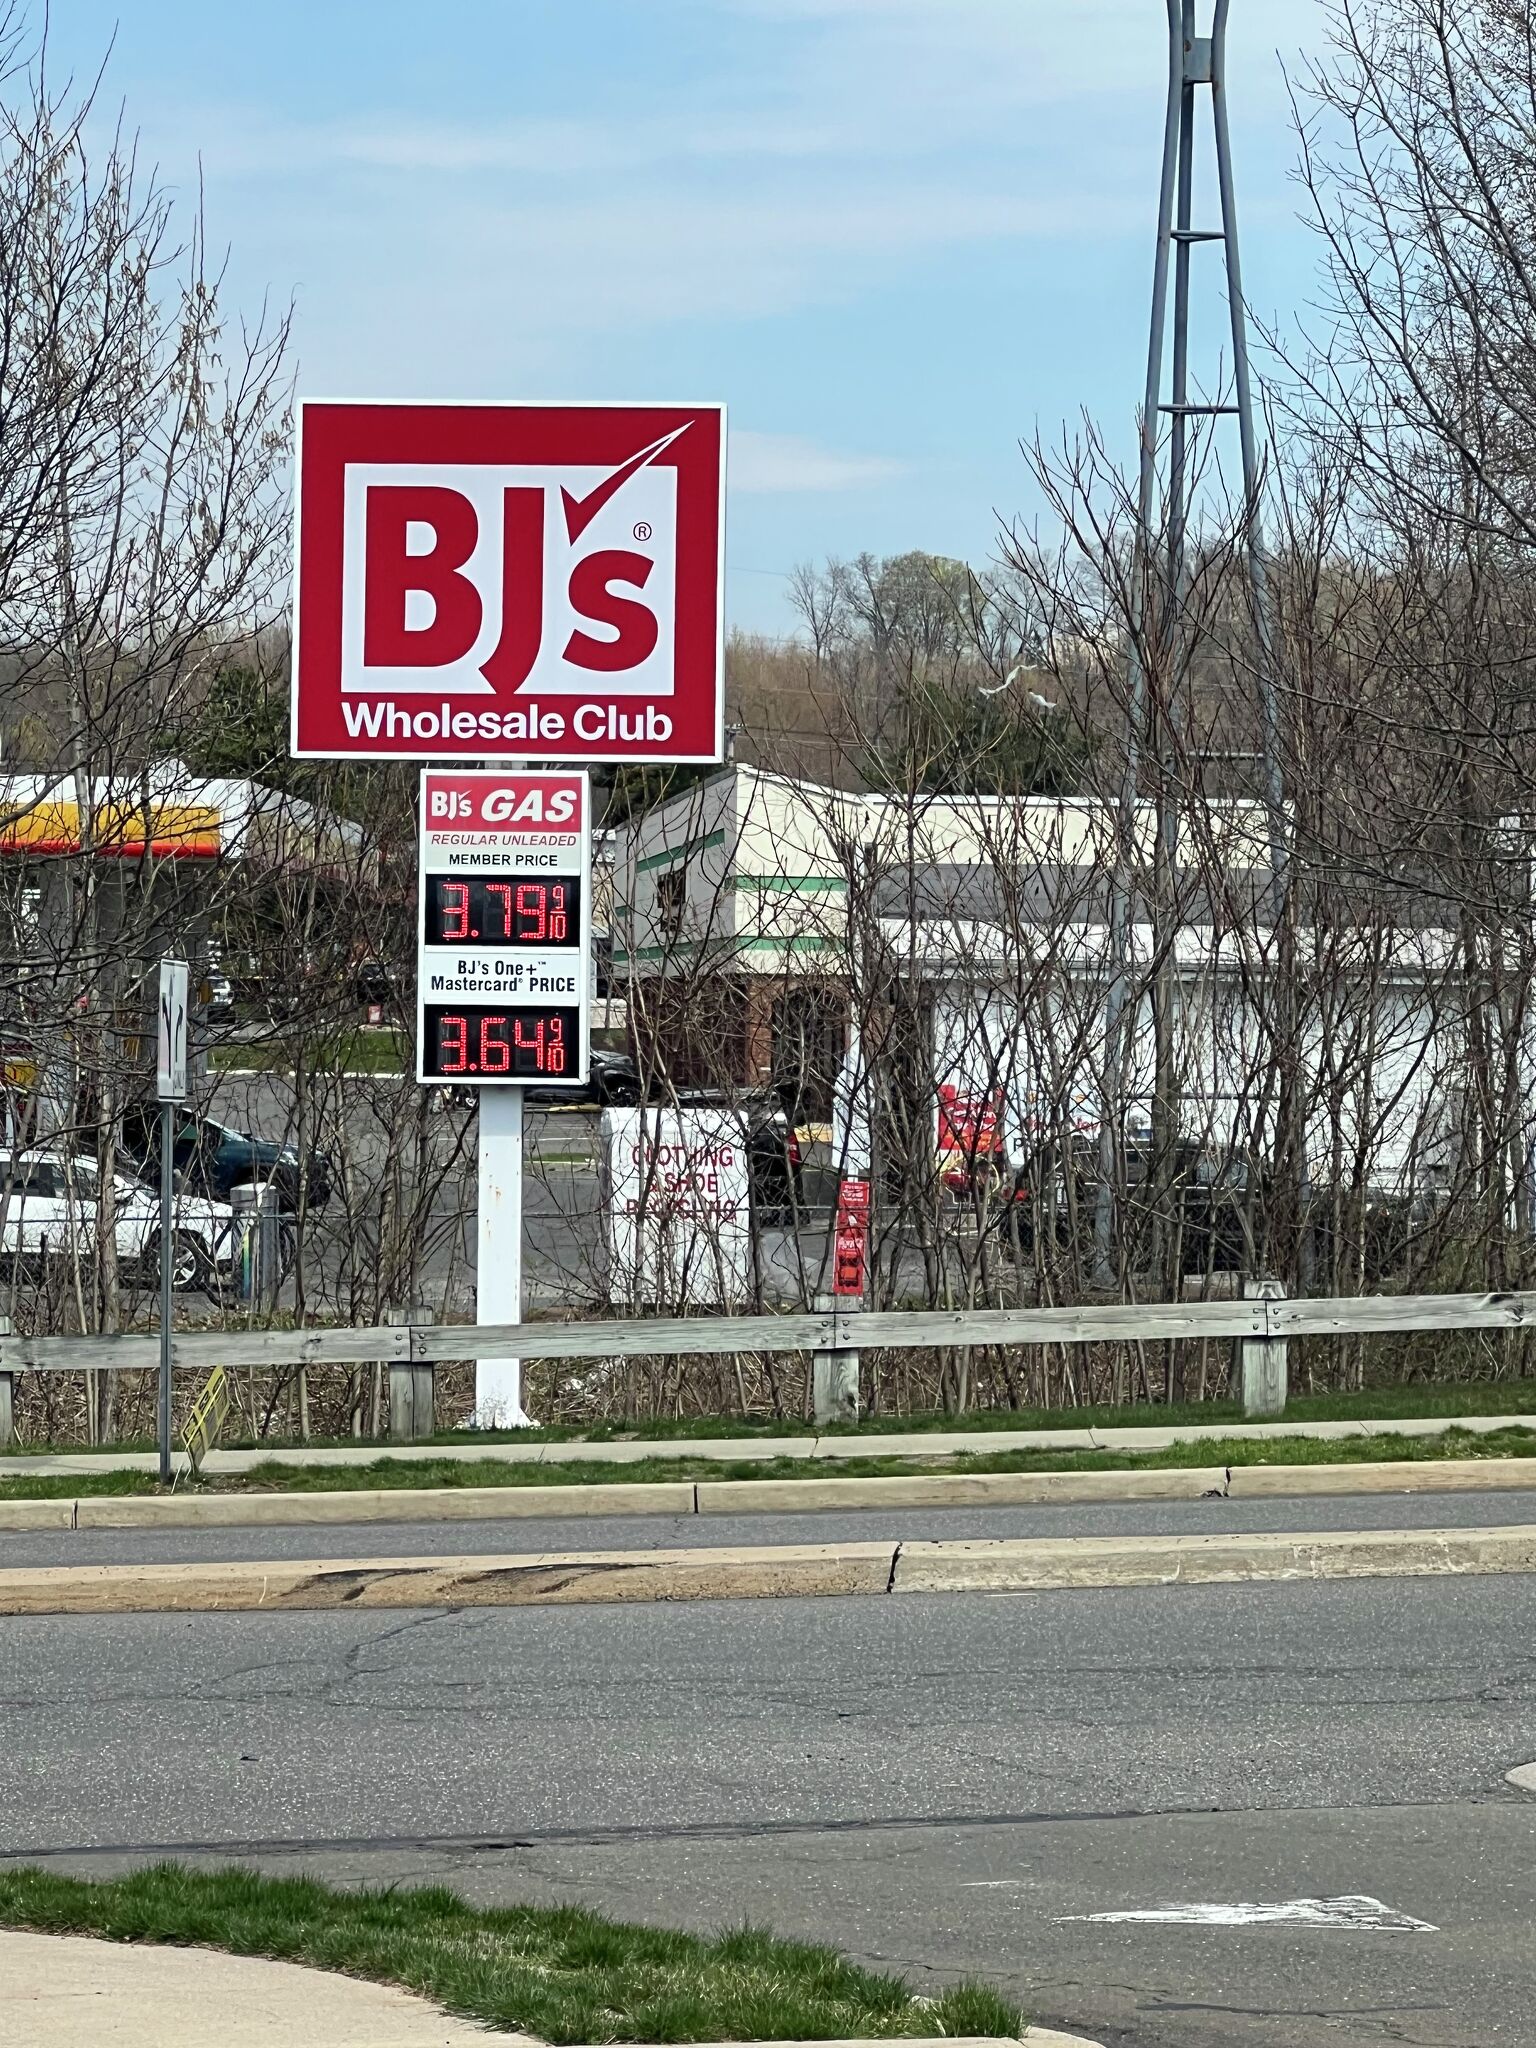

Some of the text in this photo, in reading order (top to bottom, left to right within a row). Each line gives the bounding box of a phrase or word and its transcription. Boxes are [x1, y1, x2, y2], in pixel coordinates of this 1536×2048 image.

[341, 701, 673, 741] Wholesale Club
[481, 789, 577, 822] GAS
[431, 834, 577, 847] REGULAR UNLEADED
[449, 853, 558, 867] MEMBER PRICE
[457, 960, 490, 976] BJ's
[529, 977, 576, 993] PRICE
